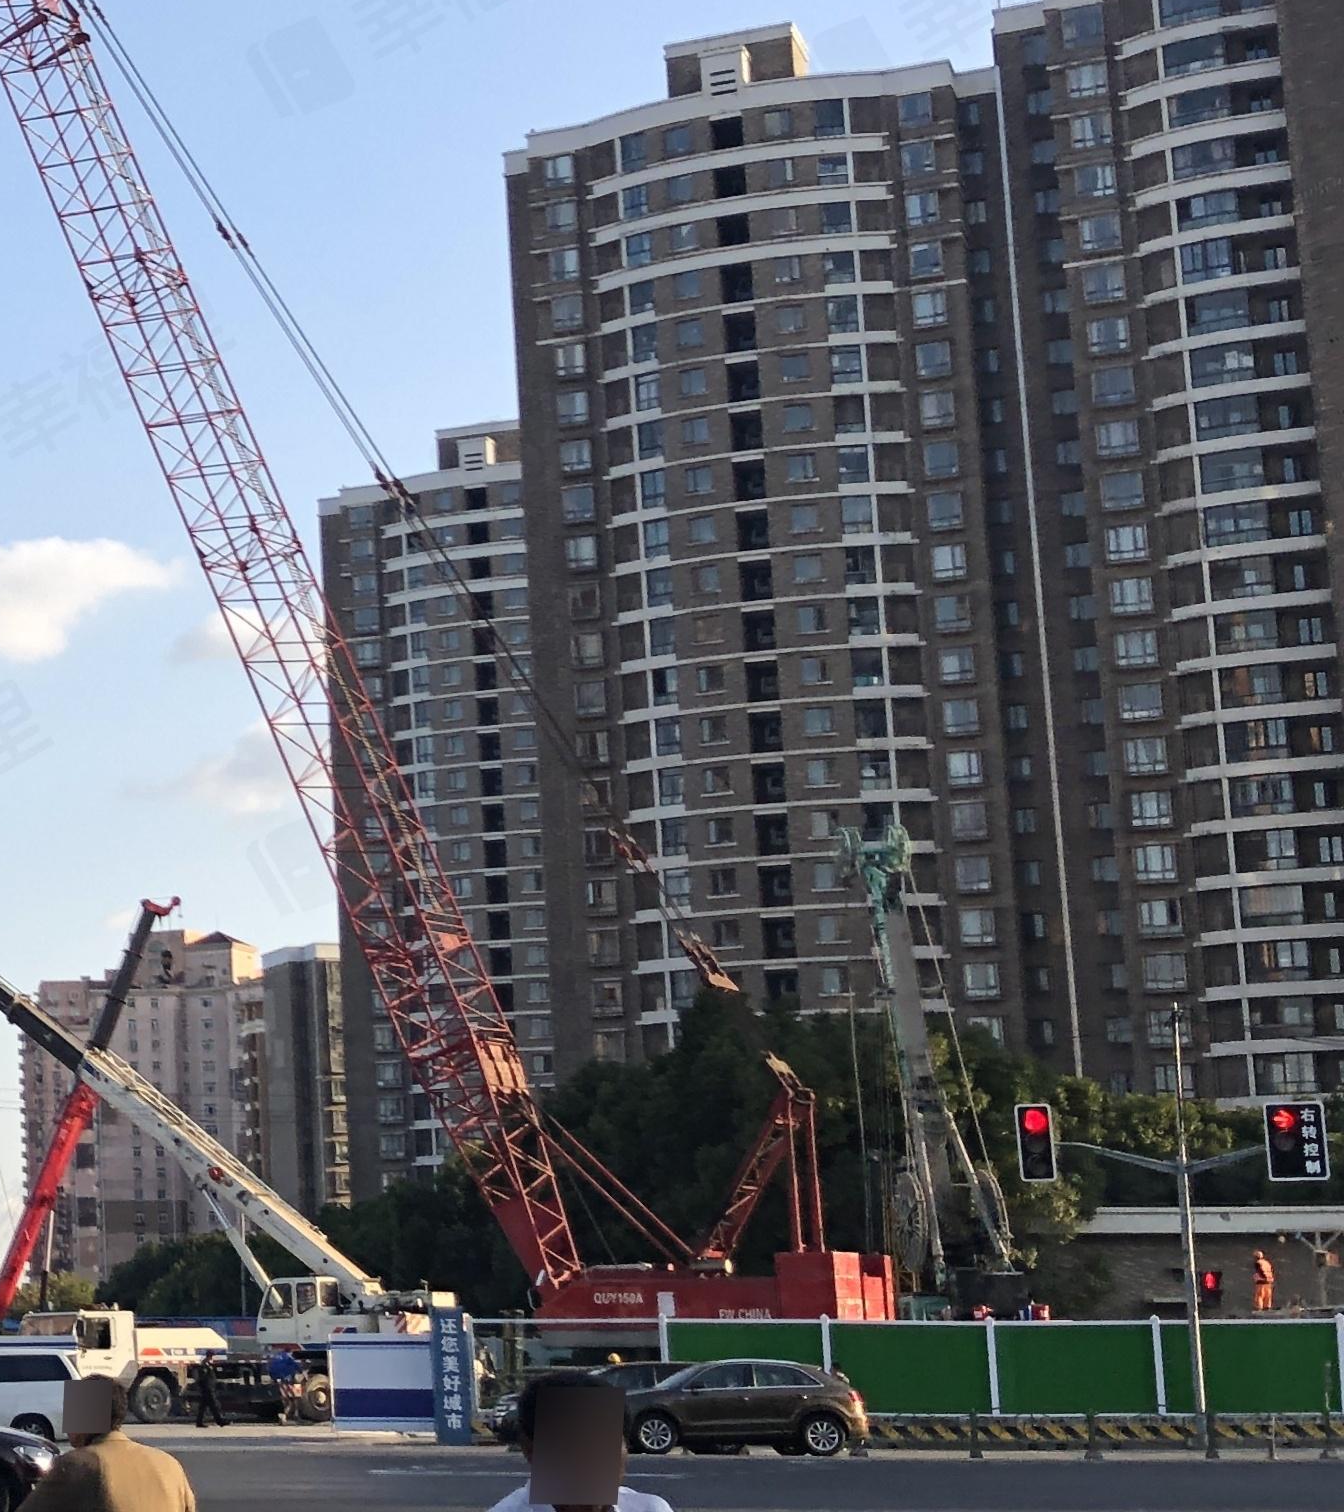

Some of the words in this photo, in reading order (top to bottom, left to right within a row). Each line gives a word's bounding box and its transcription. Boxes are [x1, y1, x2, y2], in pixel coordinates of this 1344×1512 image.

[1300, 1108, 1321, 1174] 右转控制
[440, 1318, 463, 1430] 还您美好城市
